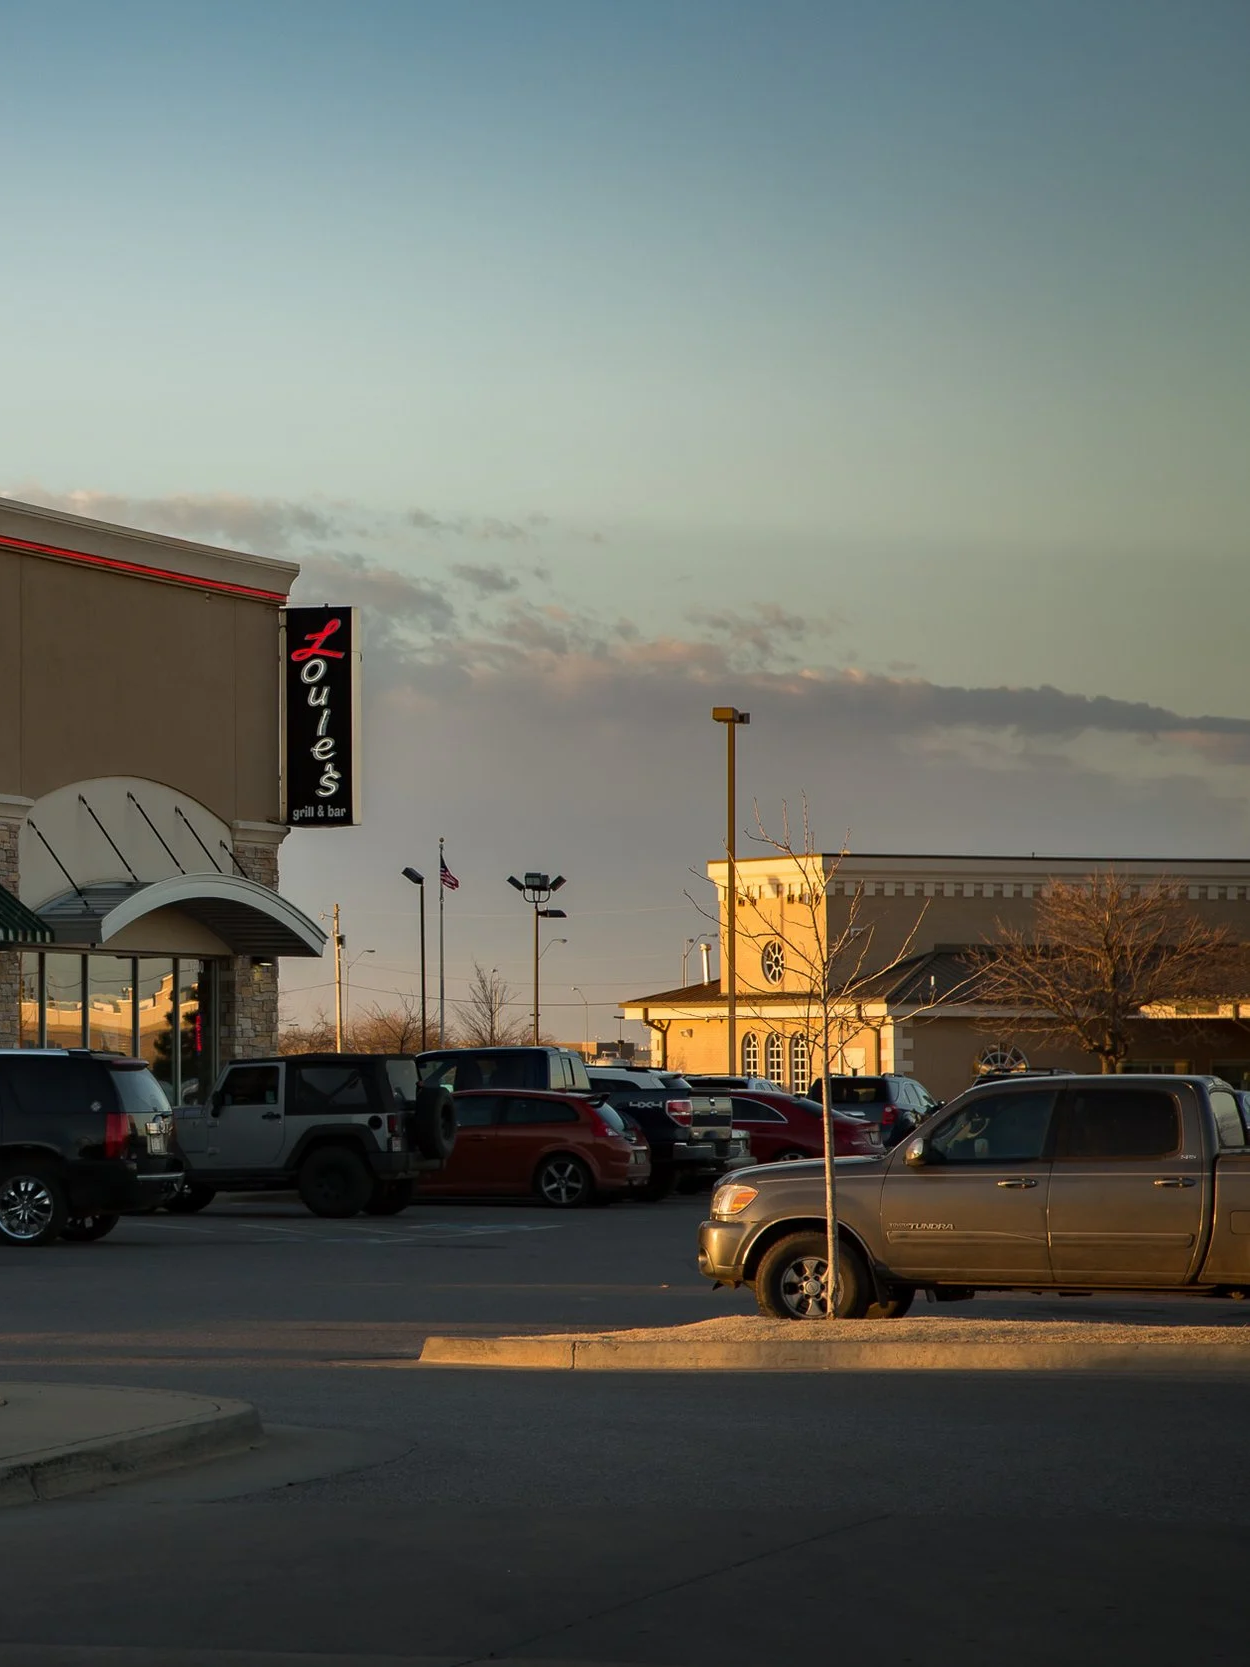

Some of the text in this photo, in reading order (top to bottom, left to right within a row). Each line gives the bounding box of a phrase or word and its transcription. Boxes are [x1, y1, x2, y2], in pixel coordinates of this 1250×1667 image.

[291, 618, 346, 798] Louie's
[292, 805, 347, 821] grill & bar
[909, 1222, 955, 1230] TUNDRA
